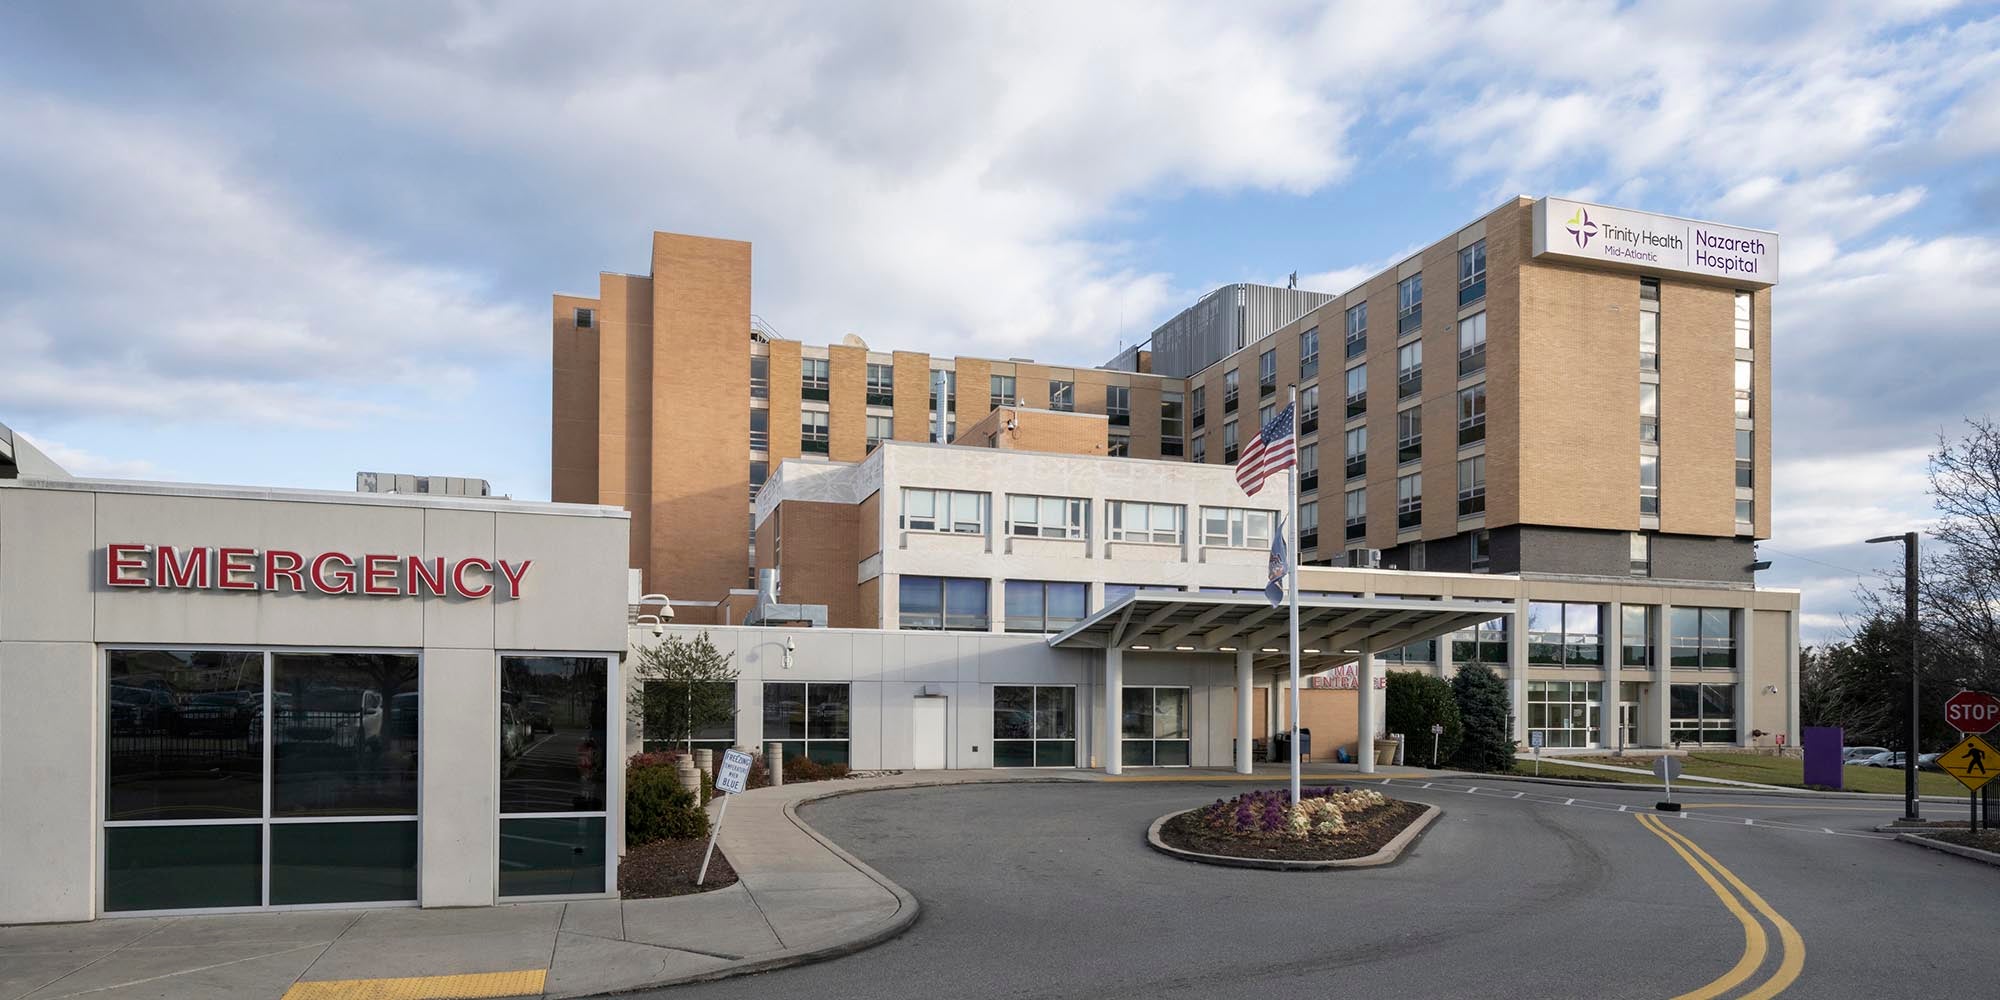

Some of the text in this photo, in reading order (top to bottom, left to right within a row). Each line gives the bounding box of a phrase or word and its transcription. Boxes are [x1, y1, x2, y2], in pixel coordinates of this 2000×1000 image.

[1602, 223, 1683, 250] Trinity Health
[1696, 229, 1765, 255] Nazareth
[1604, 245, 1657, 262] Mid-Atlantic
[1696, 253, 1758, 274] Hospital
[106, 543, 535, 599] EMERGENCY
[1334, 664, 1358, 676] MAI
[1313, 676, 1387, 689] ENTRAE
[1950, 704, 1999, 720] STOP
[722, 777, 739, 789] BLUE
